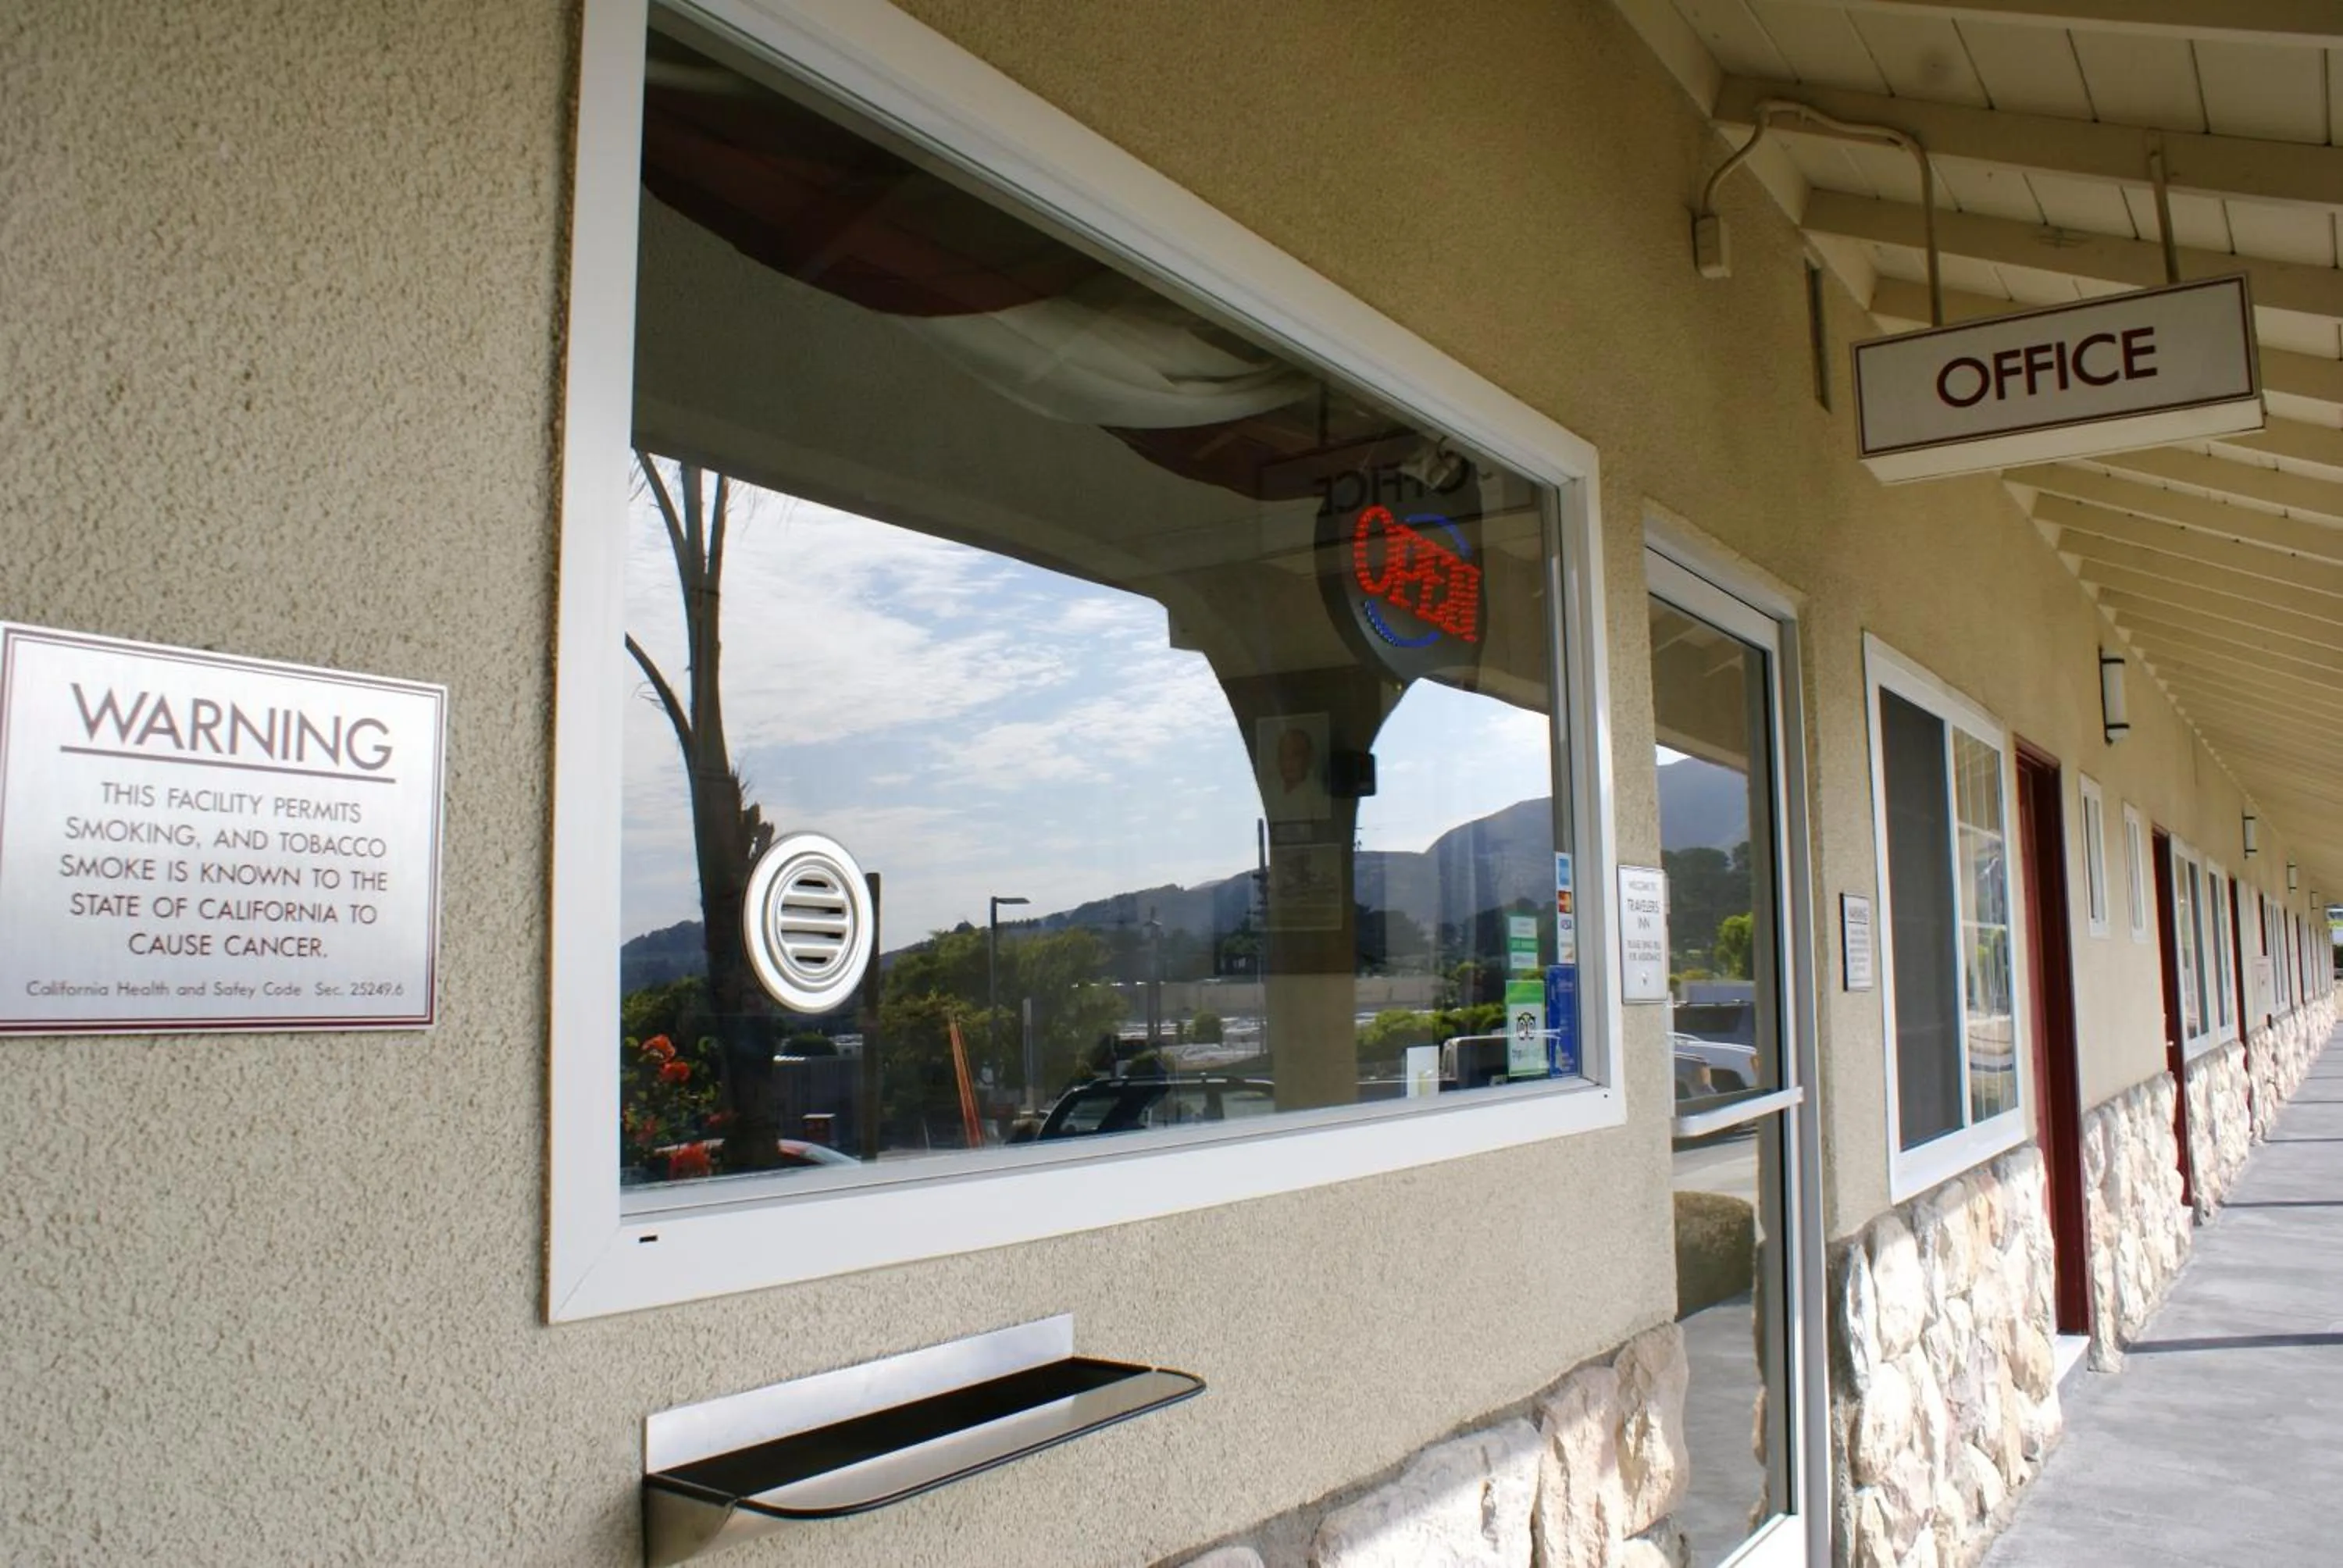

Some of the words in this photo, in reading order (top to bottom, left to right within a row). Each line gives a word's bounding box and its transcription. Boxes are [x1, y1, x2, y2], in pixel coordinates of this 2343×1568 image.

[1937, 326, 2158, 408] OFFICE
[70, 682, 393, 771] WARNING
[102, 782, 155, 807] THIS
[168, 788, 262, 814] FACILITY
[274, 797, 361, 823] PERMITS
[66, 817, 201, 850] SMOKING,
[213, 830, 268, 850] AND
[279, 832, 386, 858] TOBACCO
[60, 854, 155, 880] SMOKE
[168, 861, 187, 882] IS
[201, 864, 300, 886] KNOWN
[312, 868, 340, 889] TO
[351, 871, 387, 891] THE
[70, 893, 139, 917] STATE
[153, 896, 187, 918] OF
[198, 898, 337, 922] CALIFORNIA
[350, 904, 376, 925] TO
[129, 933, 212, 956] CAUSE
[224, 935, 326, 957] CANCER.
[26, 980, 109, 996] California
[117, 982, 169, 996] Health
[177, 982, 205, 996] and
[262, 982, 301, 996] Code
